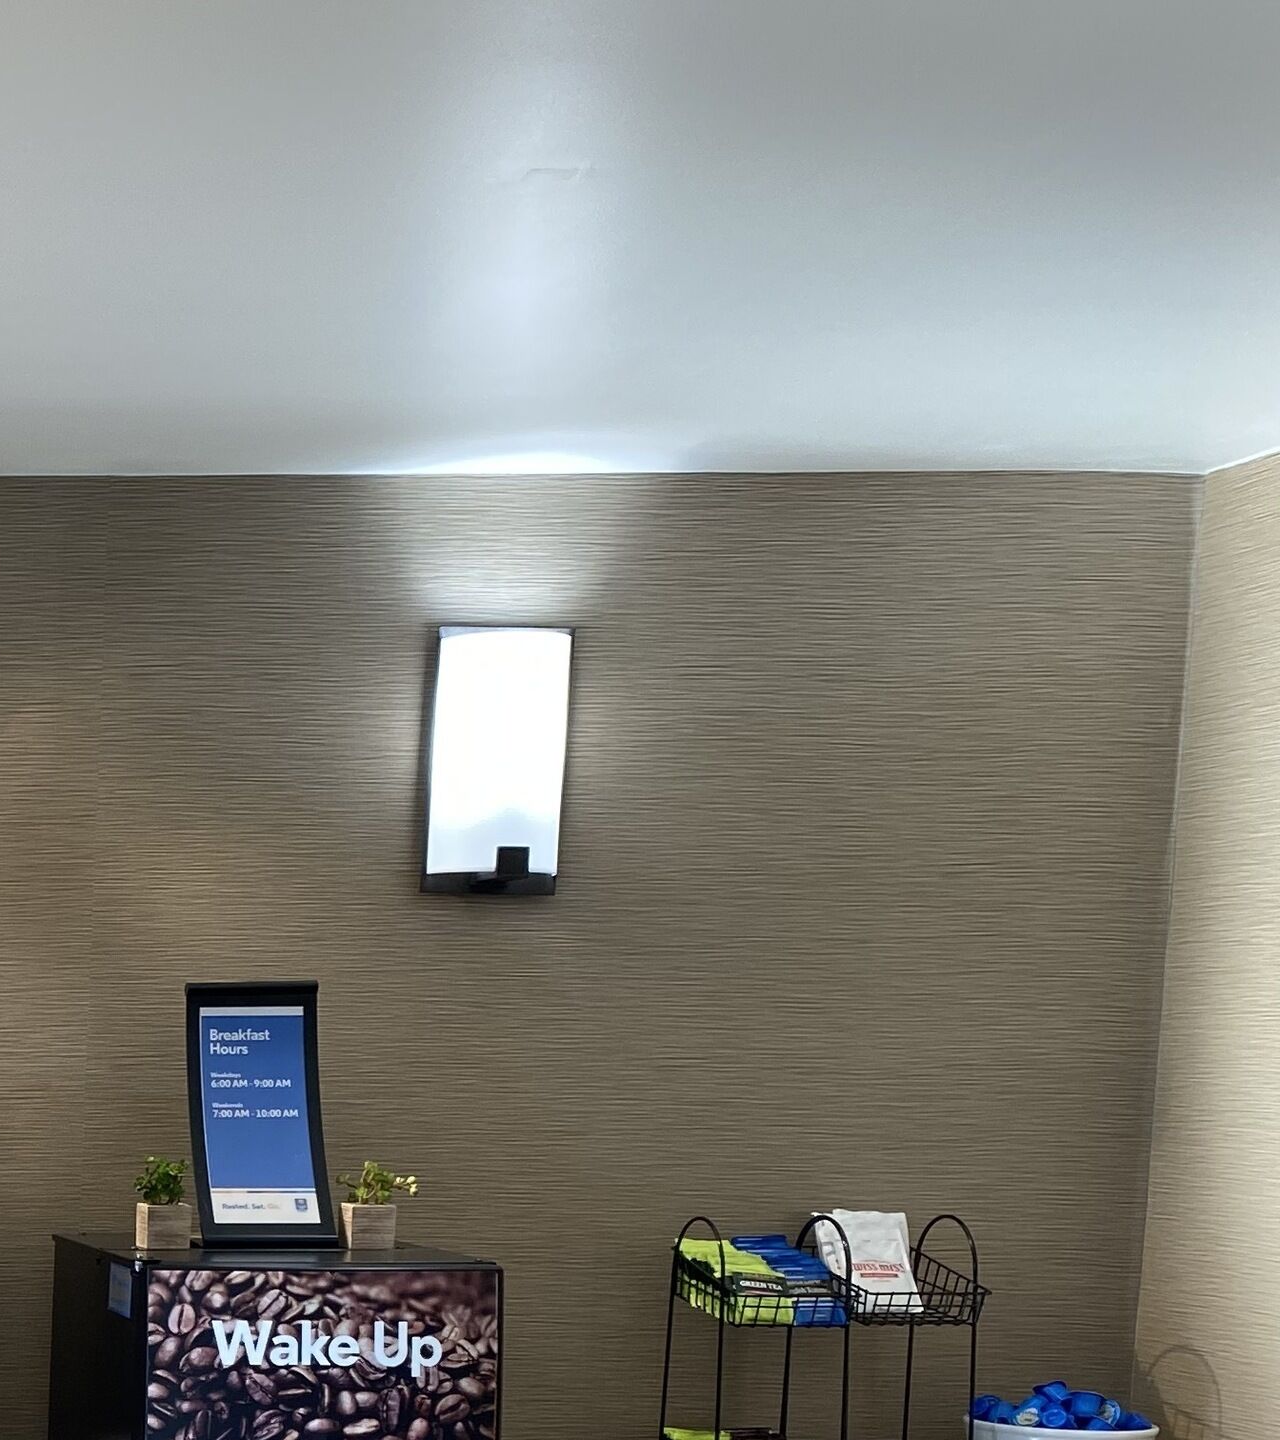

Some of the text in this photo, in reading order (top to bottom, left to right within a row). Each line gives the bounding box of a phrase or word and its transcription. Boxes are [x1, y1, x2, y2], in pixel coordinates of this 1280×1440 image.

[209, 1028, 270, 1041] Breakfast
[209, 1042, 249, 1055] Hours
[210, 1079, 231, 1088] 6:00
[232, 1079, 248, 1087] AM
[254, 1079, 274, 1088] 9:00
[275, 1079, 291, 1087] AM
[213, 1109, 233, 1118] 7:00
[234, 1109, 250, 1118] AM
[256, 1109, 281, 1118] 10:00
[282, 1109, 299, 1118] AM
[740, 1280, 767, 1289] GREEN
[767, 1283, 783, 1291] TEA
[211, 1320, 442, 1377] Wake Up
